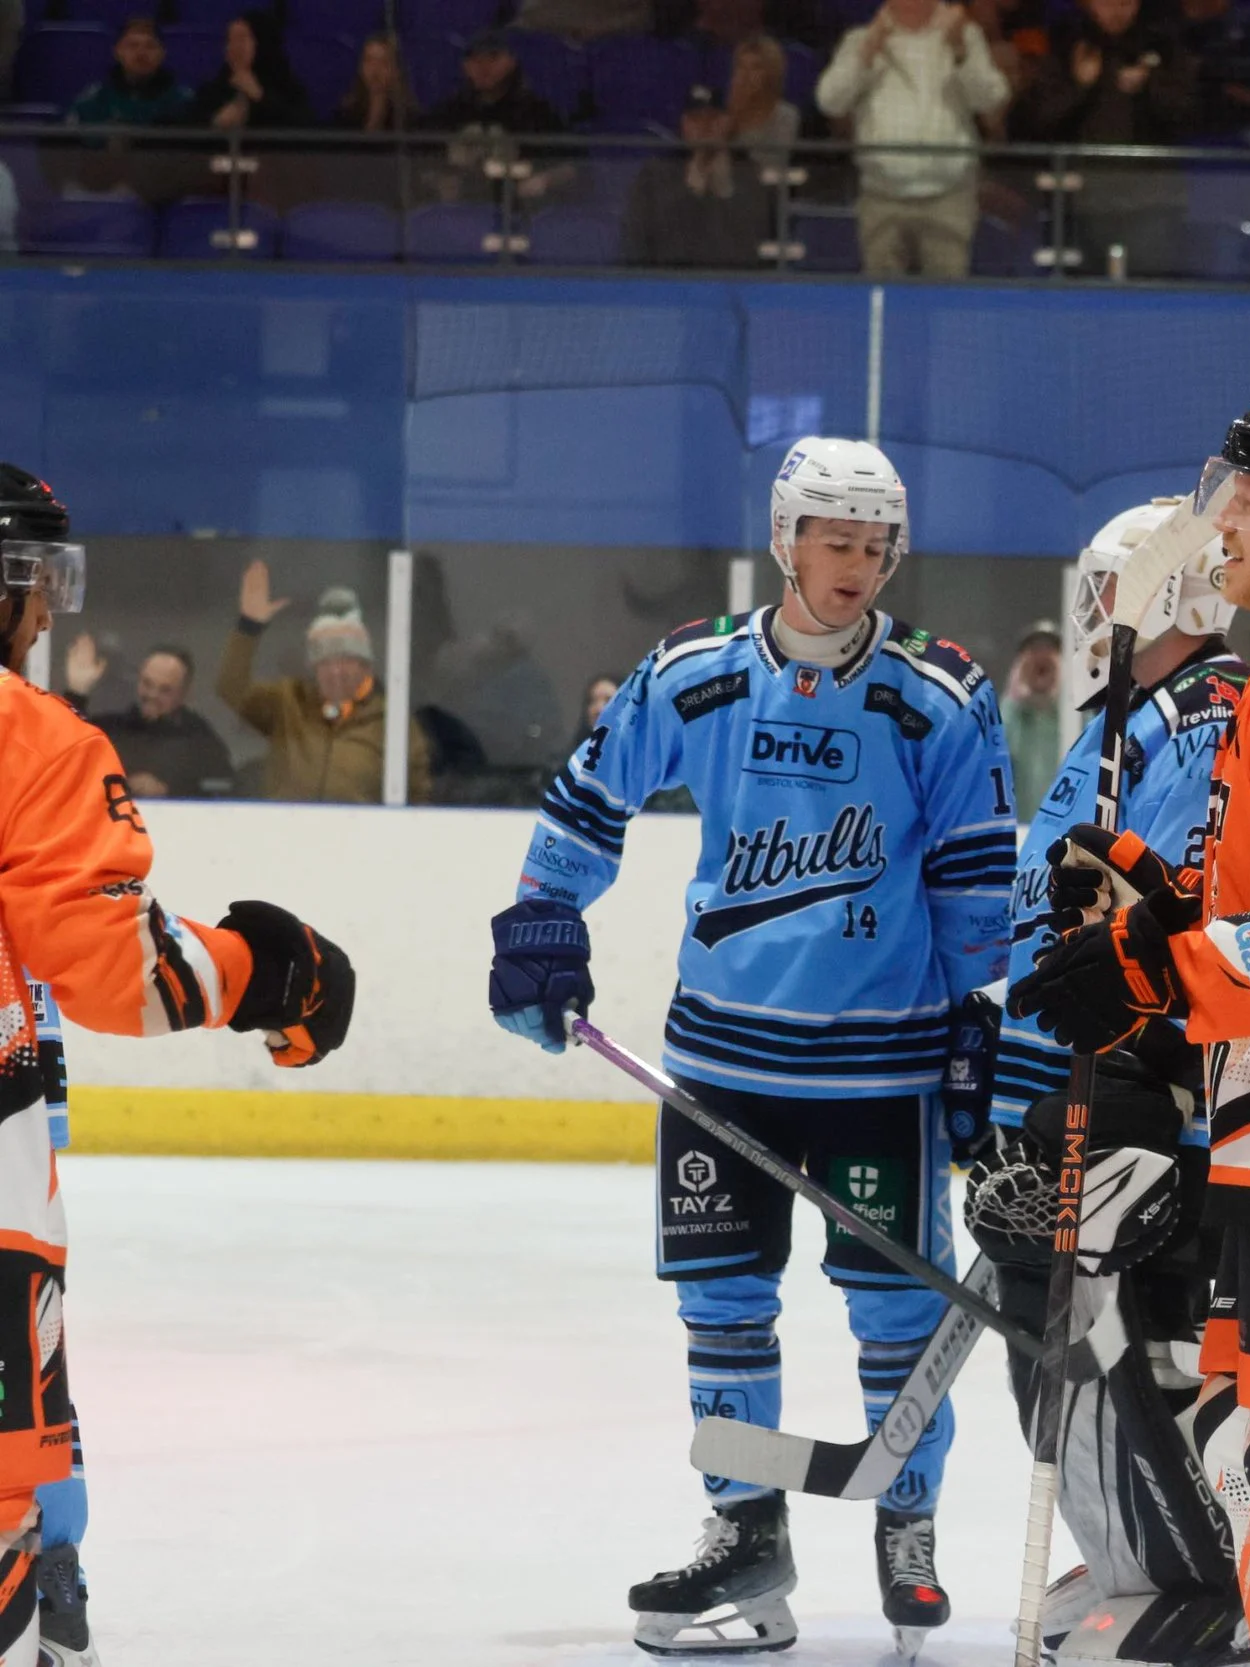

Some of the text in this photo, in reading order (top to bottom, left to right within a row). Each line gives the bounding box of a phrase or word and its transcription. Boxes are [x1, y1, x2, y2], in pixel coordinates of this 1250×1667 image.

[752, 730, 844, 770] Drive
[726, 804, 889, 896] itbulls
[842, 900, 877, 939] 14
[670, 1194, 733, 1215] TAYZ
[662, 1220, 749, 1236] WWW.TAYZ.CO.UK
